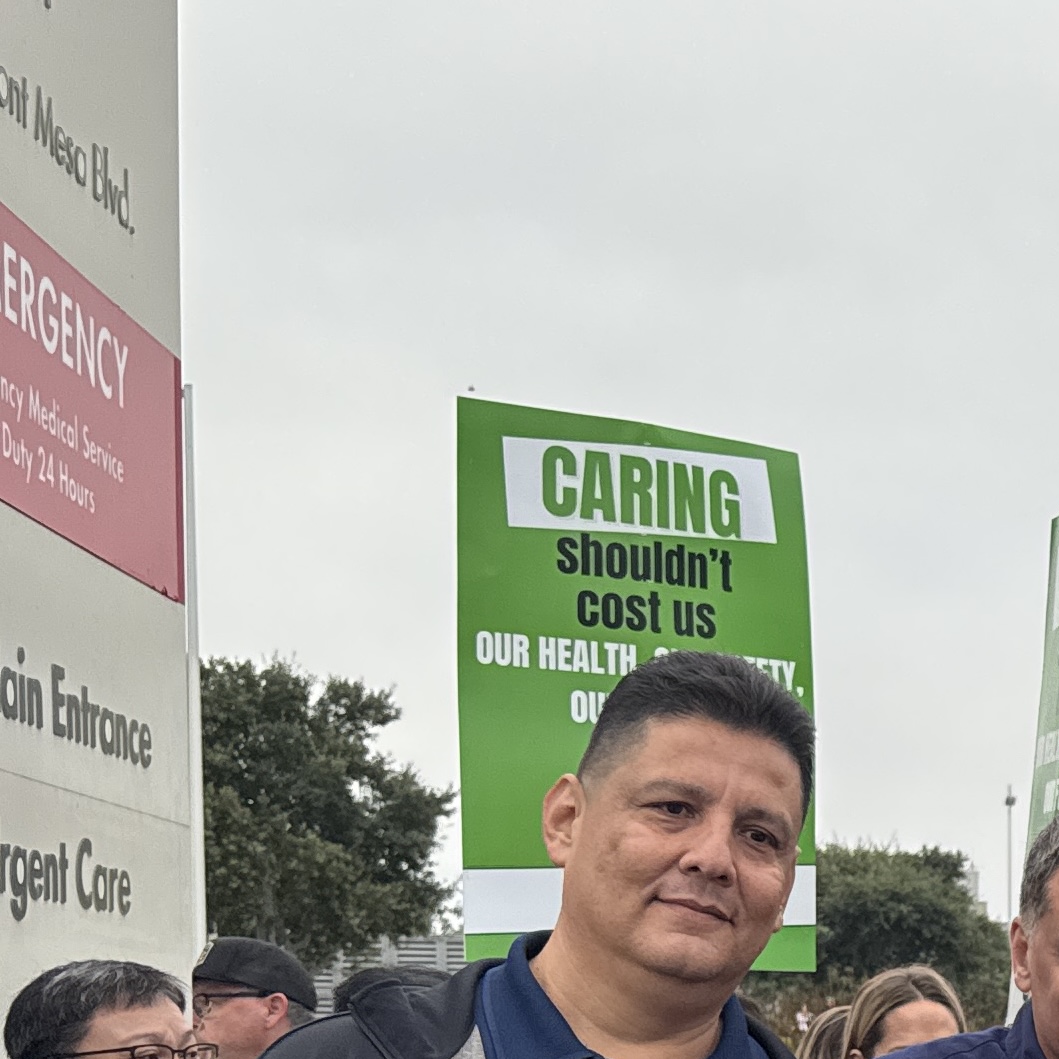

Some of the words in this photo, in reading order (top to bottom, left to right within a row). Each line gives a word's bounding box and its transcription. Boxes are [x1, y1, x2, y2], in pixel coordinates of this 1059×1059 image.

[34, 85, 86, 187] Mesa
[92, 142, 135, 236] Blvd.
[0, 241, 128, 409] ERGENCY
[2, 421, 33, 484] Duty
[38, 446, 55, 488] 24
[59, 460, 96, 514] Hours
[28, 384, 79, 452] Medical
[82, 424, 124, 484] Service
[541, 446, 741, 539] CARING
[556, 533, 733, 593] shouldn't
[475, 630, 530, 668] OUR
[576, 590, 661, 635] cost
[673, 603, 716, 639] us
[0, 646, 43, 729] ain
[51, 663, 152, 769] Entrance
[570, 690, 608, 724] OU
[75, 837, 131, 916] Care
